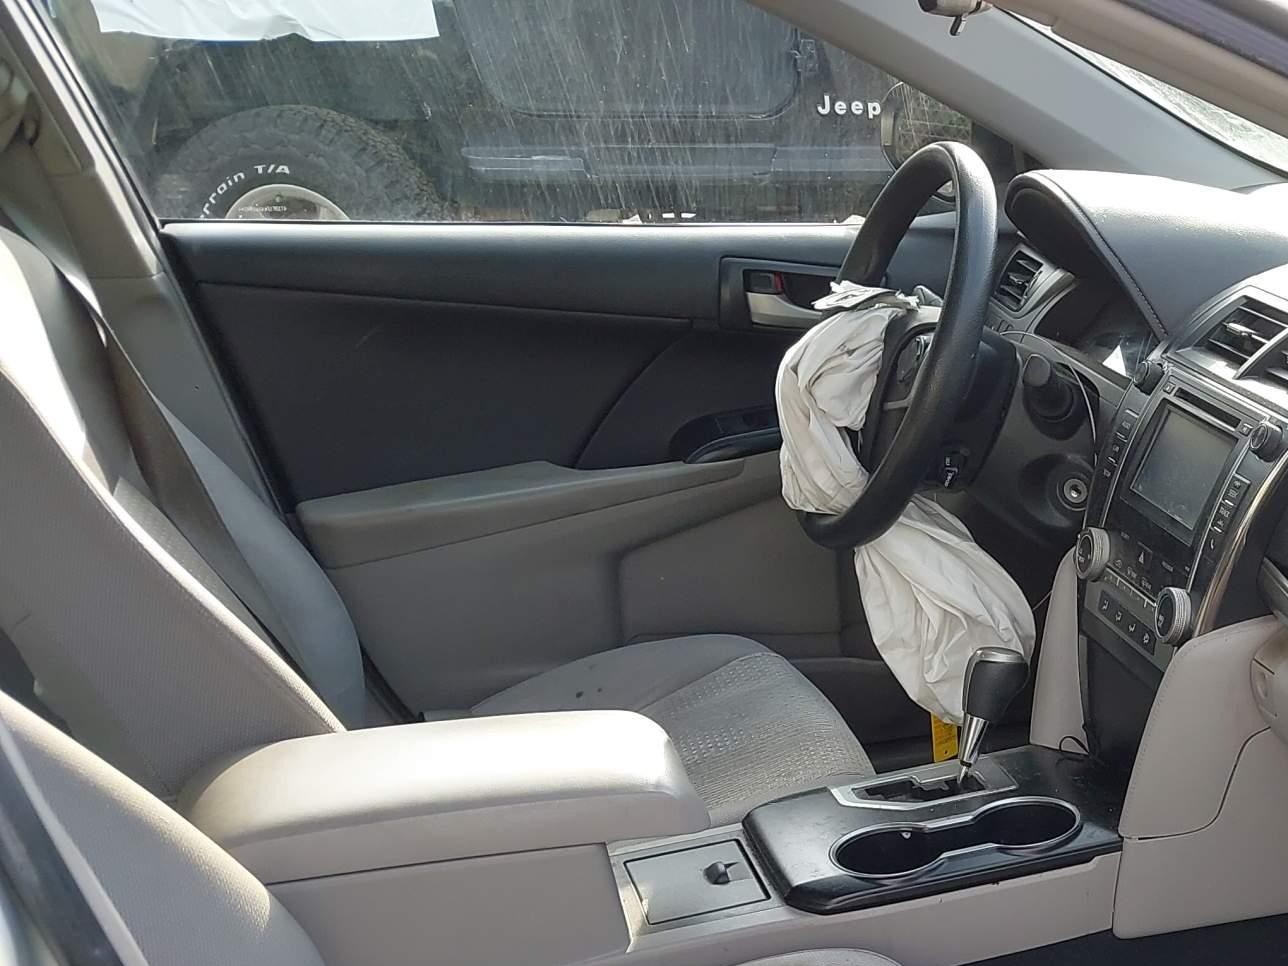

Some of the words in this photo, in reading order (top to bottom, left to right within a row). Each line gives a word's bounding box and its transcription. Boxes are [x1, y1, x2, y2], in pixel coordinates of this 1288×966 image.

[816, 94, 881, 119] Jeep
[200, 172, 245, 219] rrain
[253, 163, 290, 175] T/A
